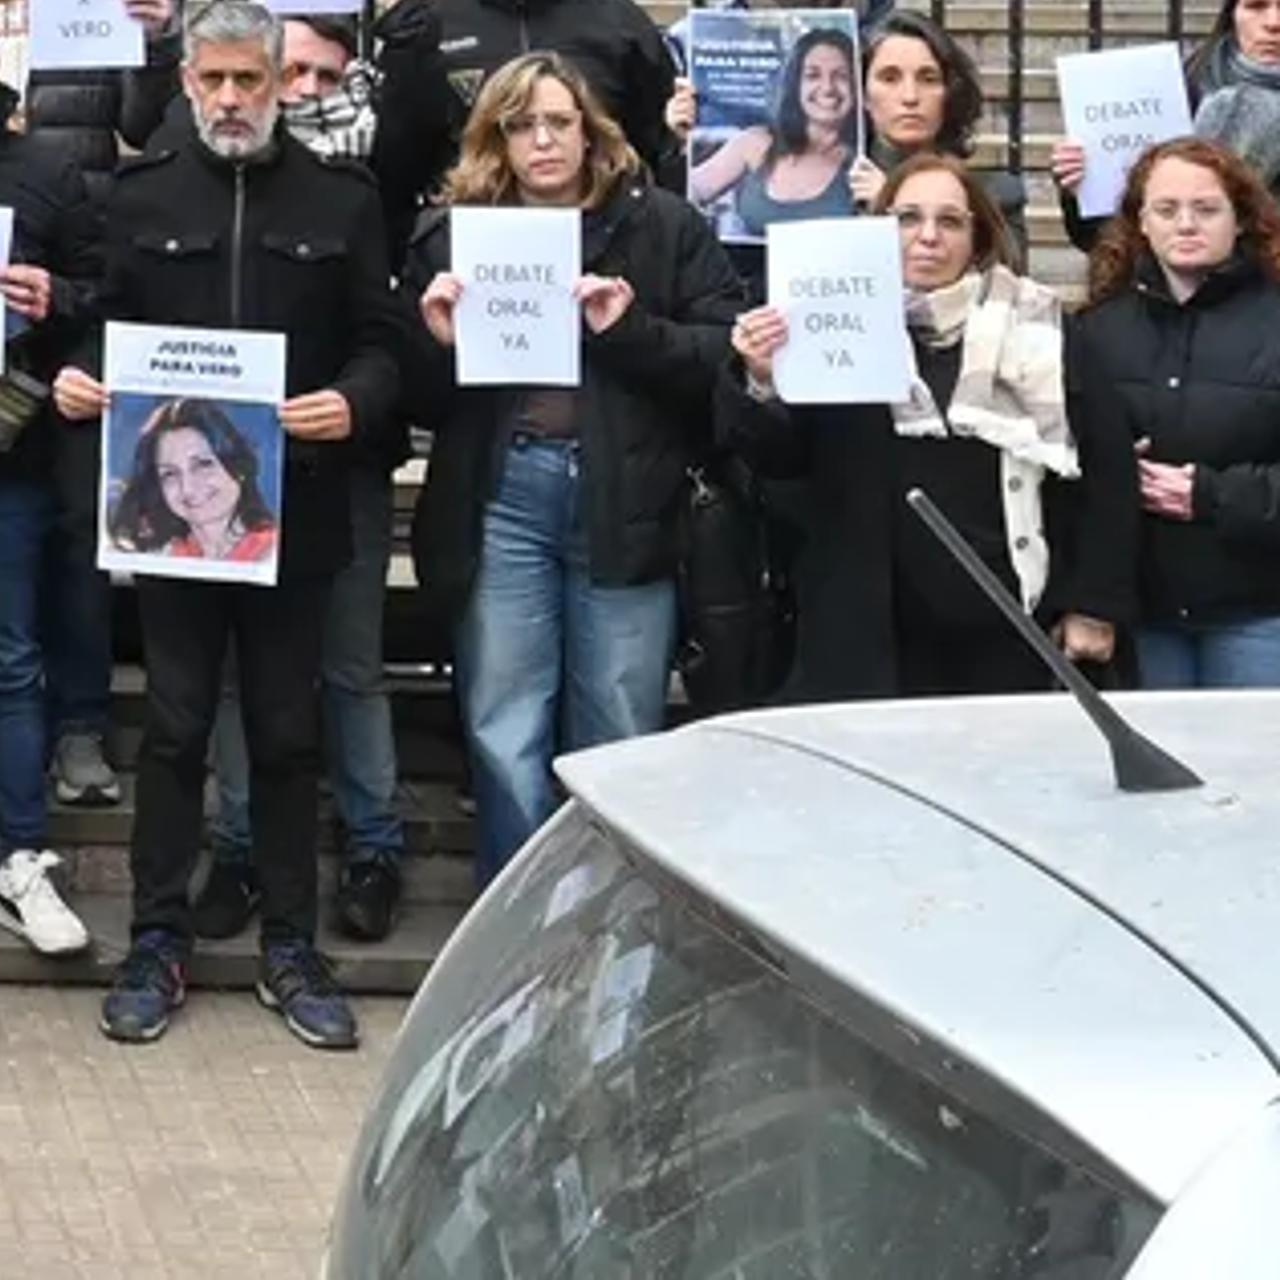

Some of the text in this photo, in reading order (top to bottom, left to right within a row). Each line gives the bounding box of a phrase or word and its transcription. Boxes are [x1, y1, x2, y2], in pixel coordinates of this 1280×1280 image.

[60, 22, 111, 38] VERO
[1085, 98, 1164, 122] DEBATE
[474, 264, 555, 284] DEBATE
[789, 276, 877, 298] DEBATE
[487, 297, 543, 318] ORAL
[804, 313, 866, 334] ORAL
[158, 341, 237, 357] JUSTICIA
[500, 332, 529, 350] YA
[150, 359, 243, 376] PARA VERO
[823, 349, 854, 367] YA
